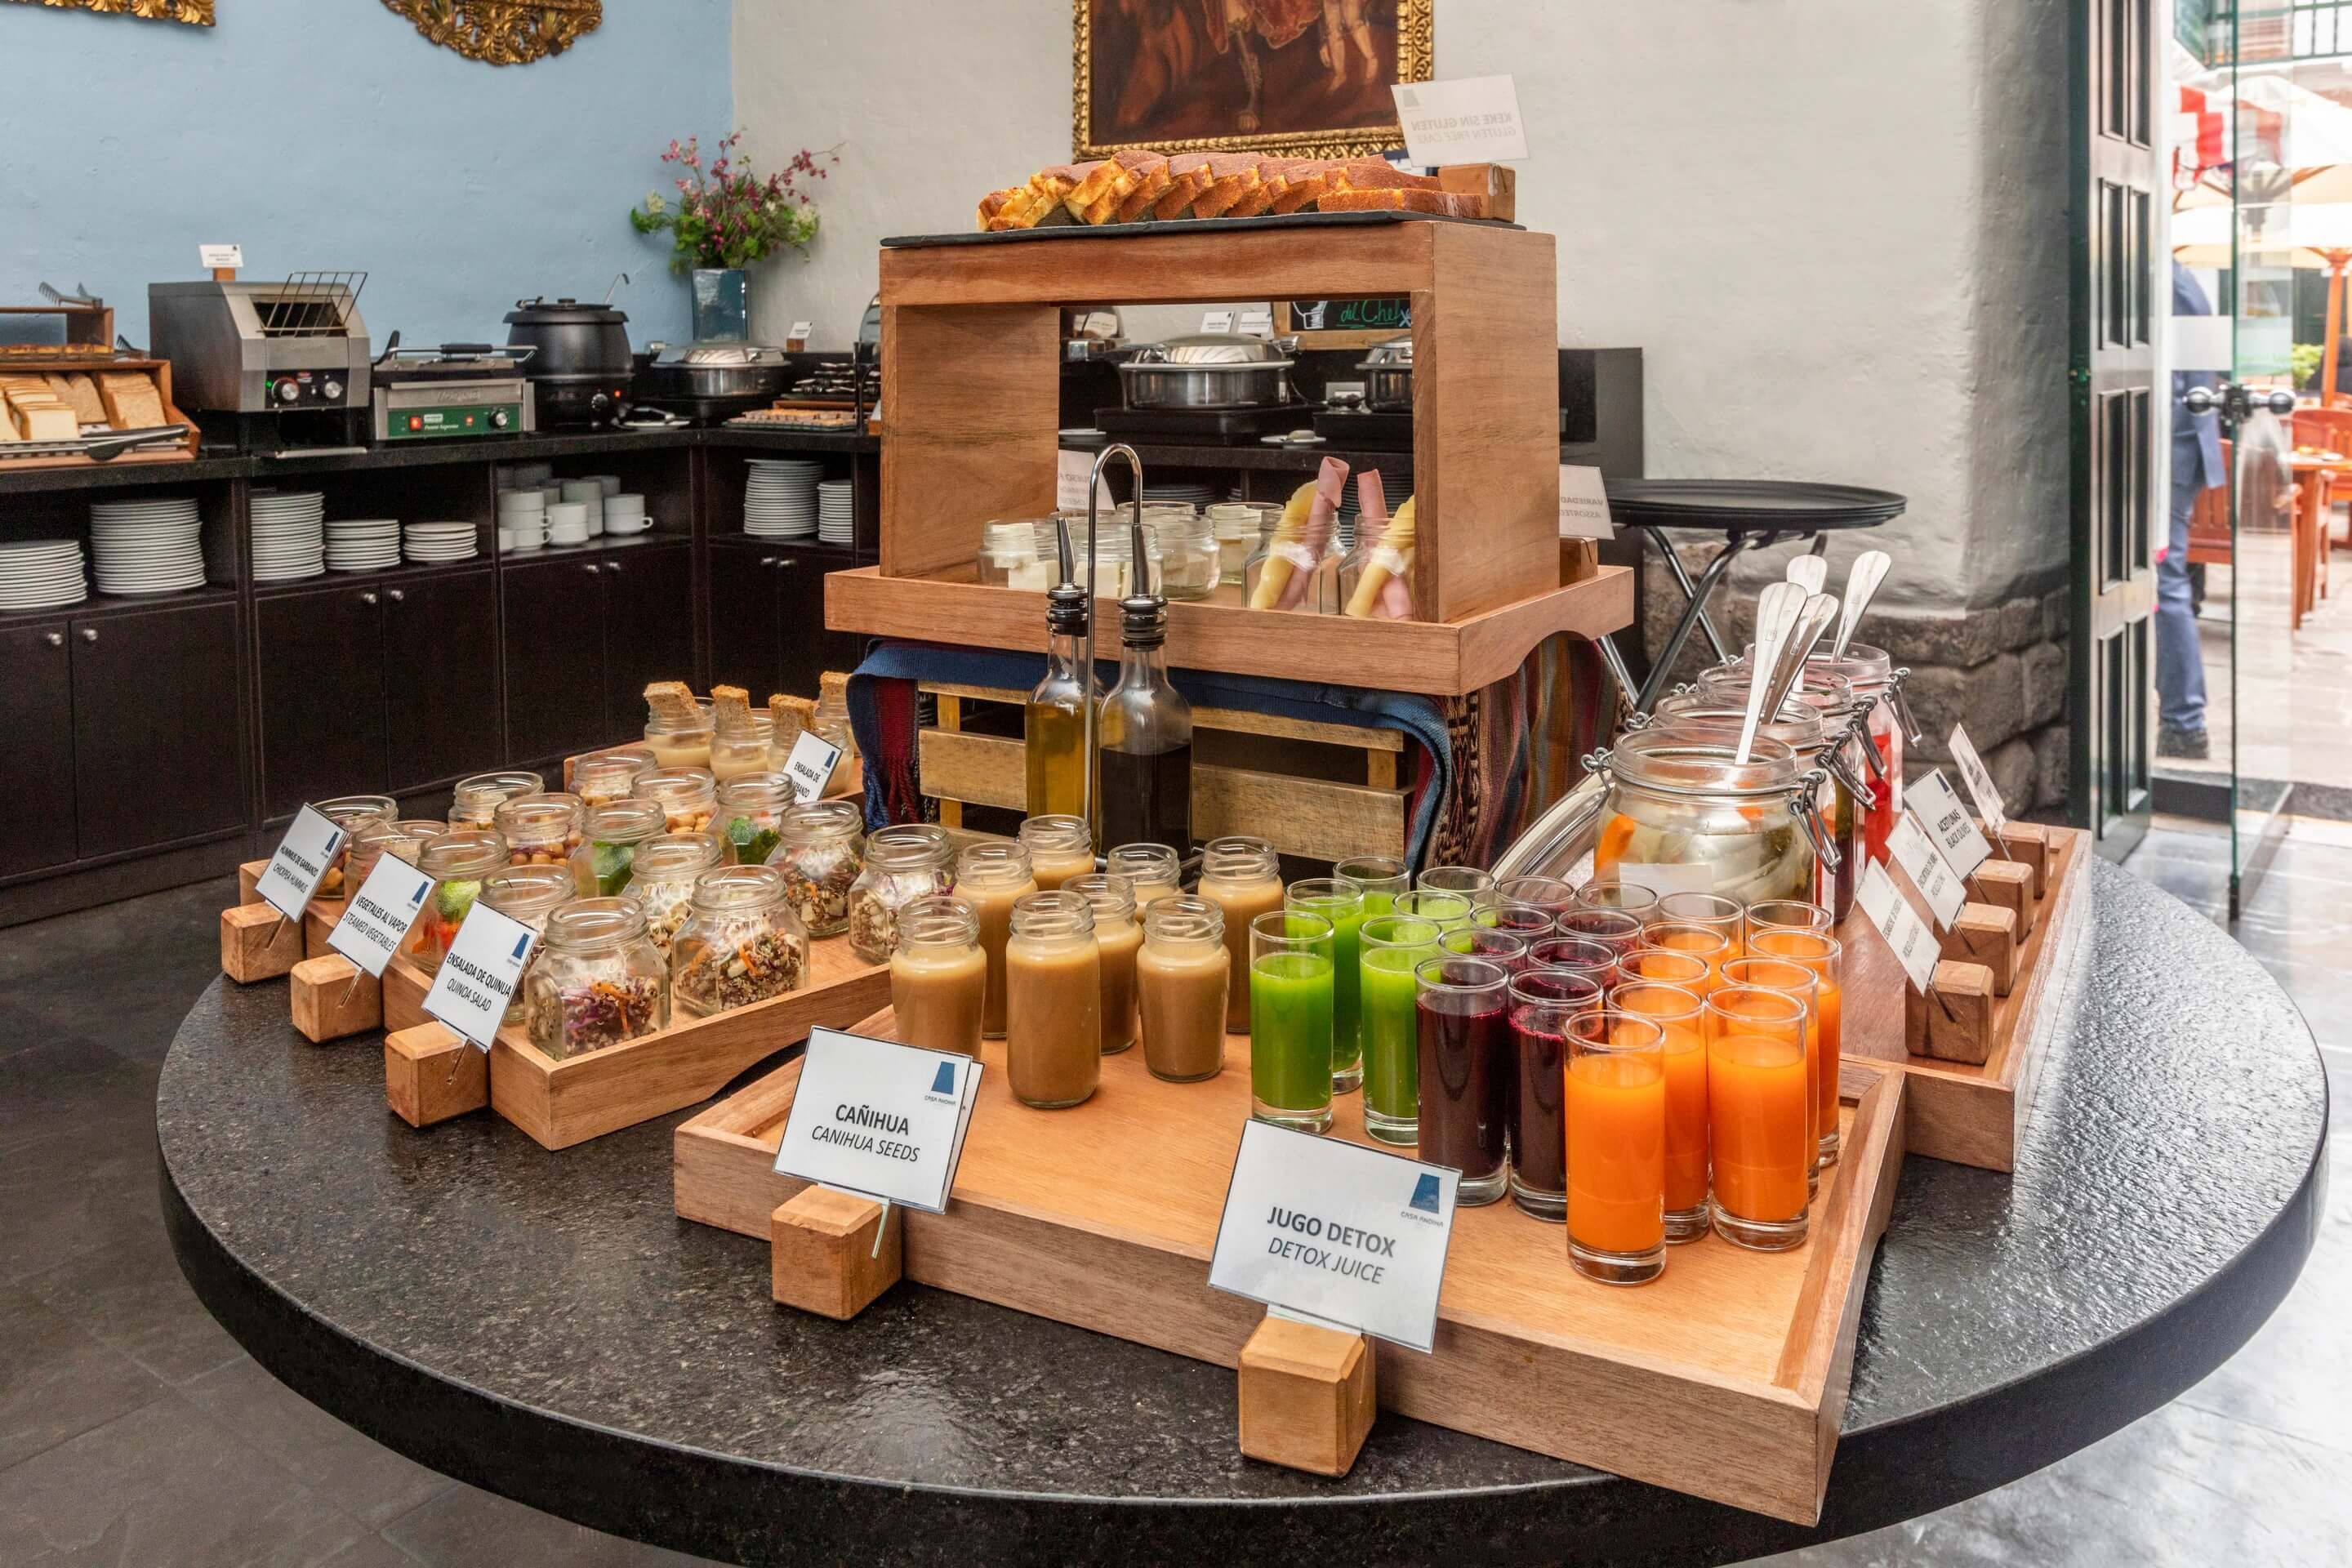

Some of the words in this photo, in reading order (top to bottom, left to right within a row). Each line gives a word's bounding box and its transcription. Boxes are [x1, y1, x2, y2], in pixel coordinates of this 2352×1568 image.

[794, 761, 814, 780] ENSALADA
[813, 773, 821, 782] DE
[1945, 831, 1960, 849] BLACK
[1956, 822, 1971, 840] OLIVES
[280, 844, 297, 862] HUMMUS
[295, 855, 302, 866] DE
[273, 863, 292, 880] CHICKPEA
[288, 874, 308, 893] HUMMUS
[343, 911, 368, 933] STEAMED
[365, 925, 397, 952] VEGETABLES
[355, 895, 384, 918] VEGETALES
[380, 911, 390, 924] AL
[387, 915, 408, 934] VAPOR
[447, 952, 476, 978] ENSALADA
[476, 969, 487, 983] DE
[485, 974, 512, 998] QUINUA
[447, 978, 470, 1000] QUINOA
[470, 992, 492, 1012] SALAD
[835, 1103, 909, 1135] CAÑIHUA
[812, 1125, 873, 1152] CANIHUA
[875, 1139, 920, 1163] SEEDS
[1267, 1206, 1322, 1236] JUGO
[1326, 1222, 1397, 1258] DETOX
[1401, 1211, 1418, 1221] CASA
[1267, 1236, 1330, 1270] DETOX
[1330, 1255, 1386, 1285] JUICE
